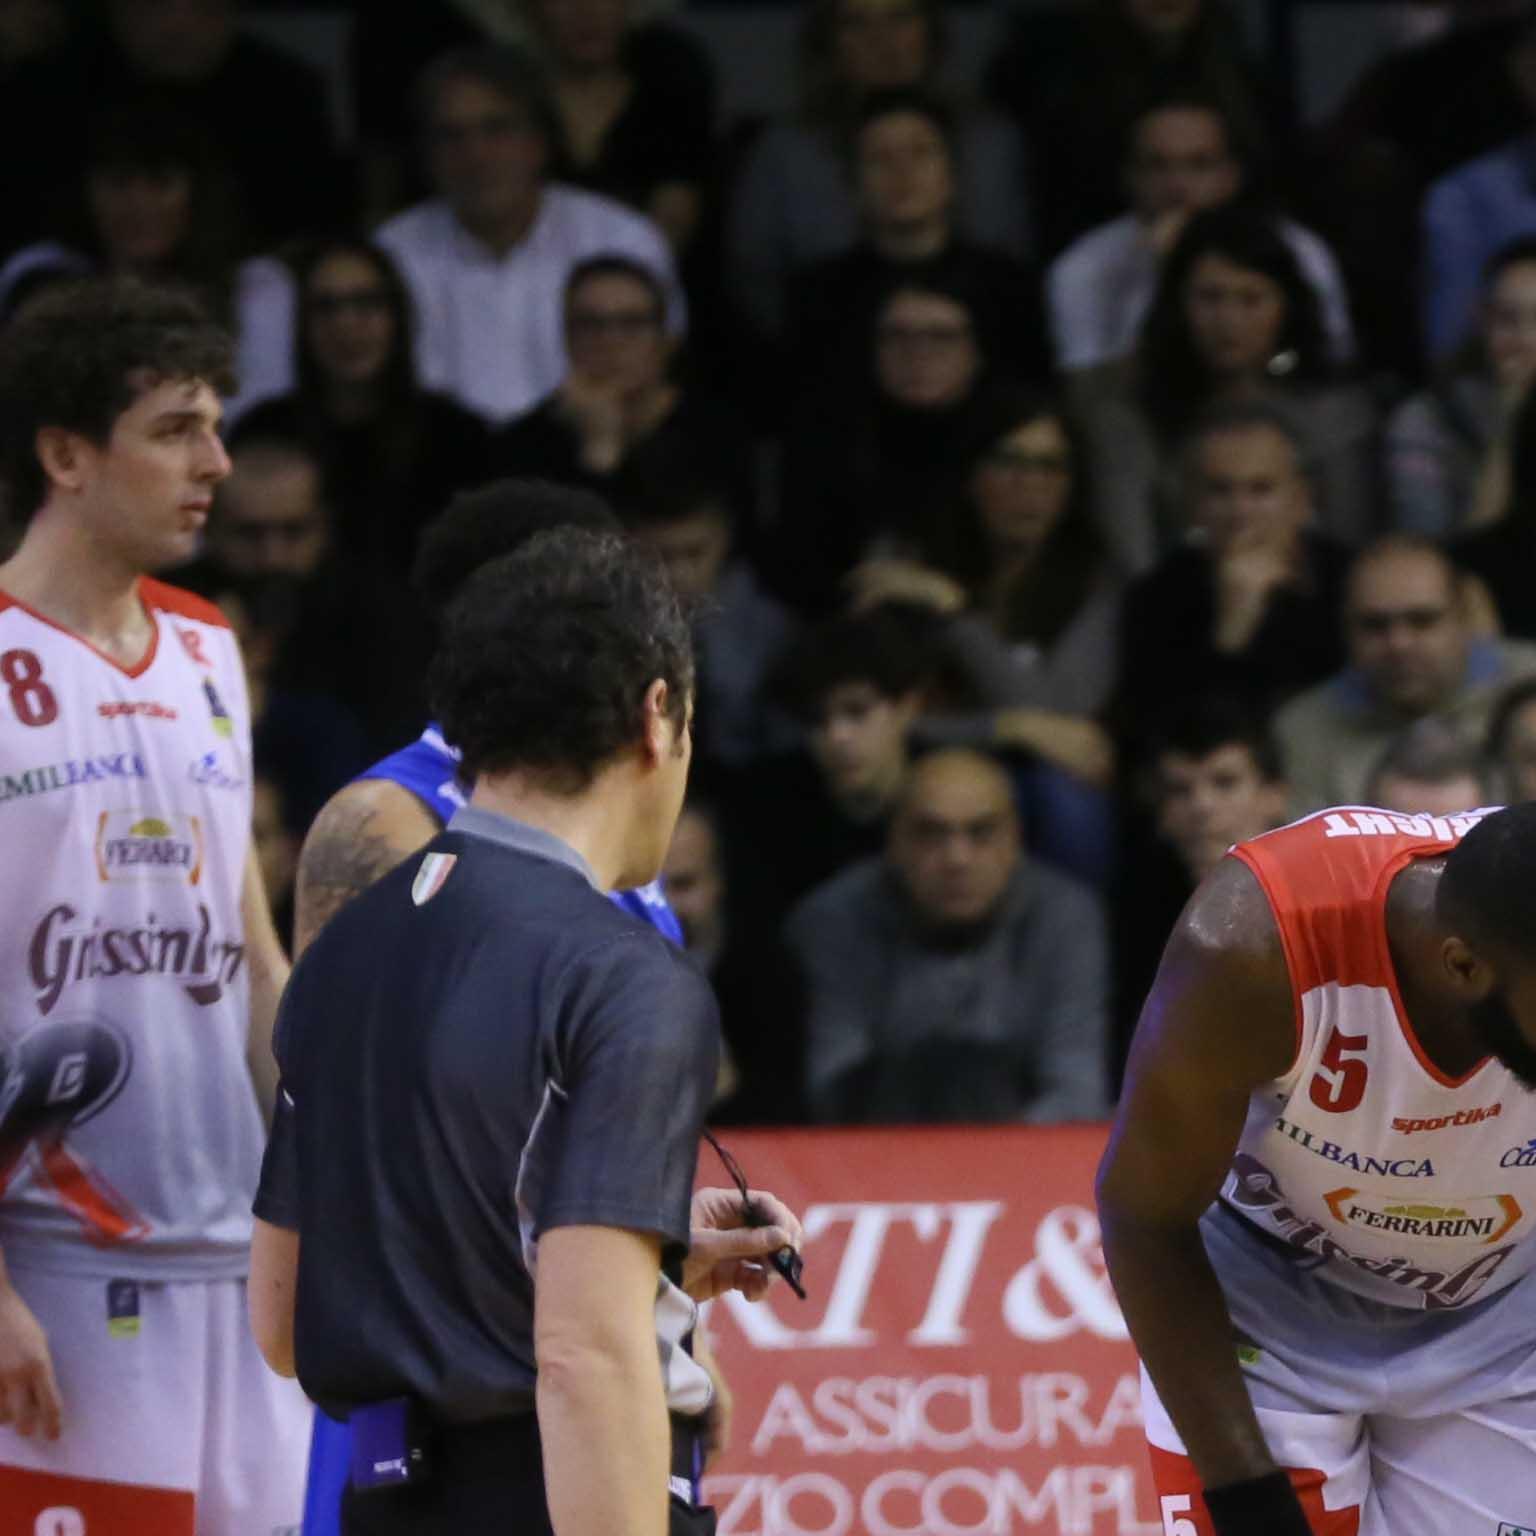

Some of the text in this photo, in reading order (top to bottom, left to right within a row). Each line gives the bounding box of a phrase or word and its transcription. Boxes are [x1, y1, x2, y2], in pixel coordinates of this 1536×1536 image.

[1, 648, 59, 728] 8
[1309, 1025, 1368, 1113] 5
[1391, 1102, 1502, 1136] sportika
[1347, 1204, 1497, 1239] FERRARINI
